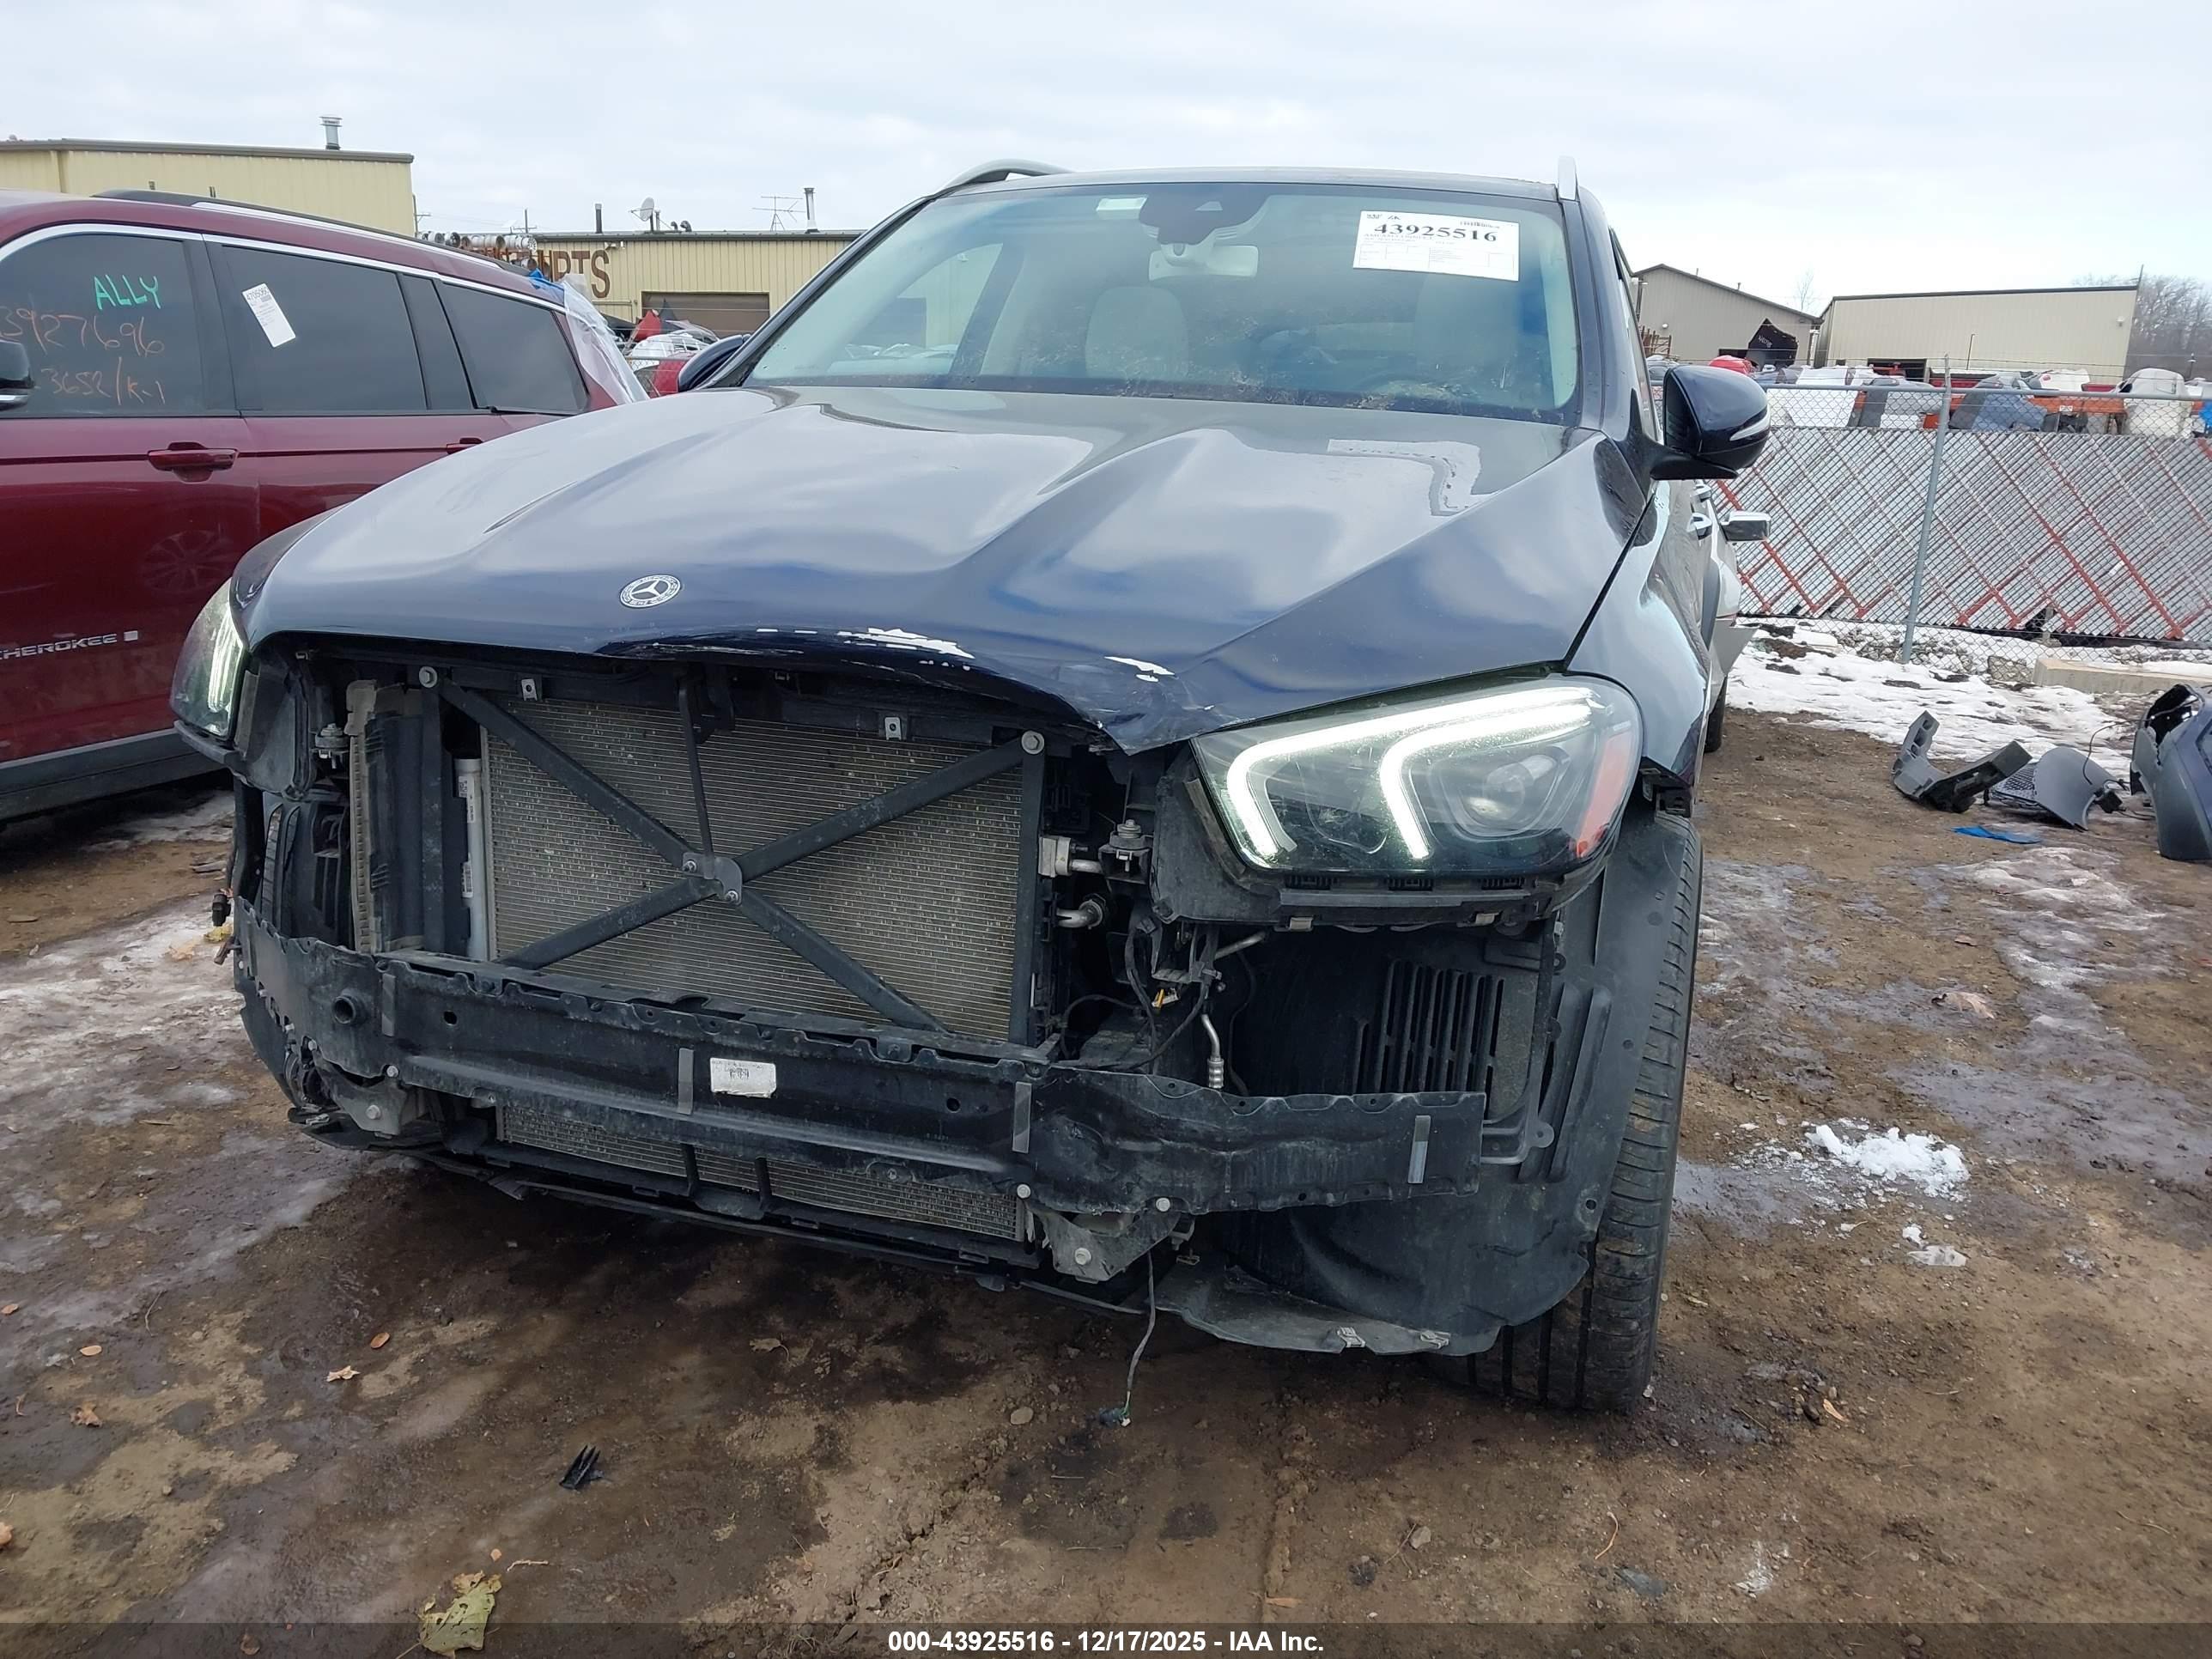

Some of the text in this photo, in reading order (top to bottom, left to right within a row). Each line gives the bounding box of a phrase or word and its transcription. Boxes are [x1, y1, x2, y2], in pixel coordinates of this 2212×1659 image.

[1374, 223, 1498, 243] 43925516
[94, 274, 161, 310] ALLY
[0, 633, 118, 660] HEROKEE
